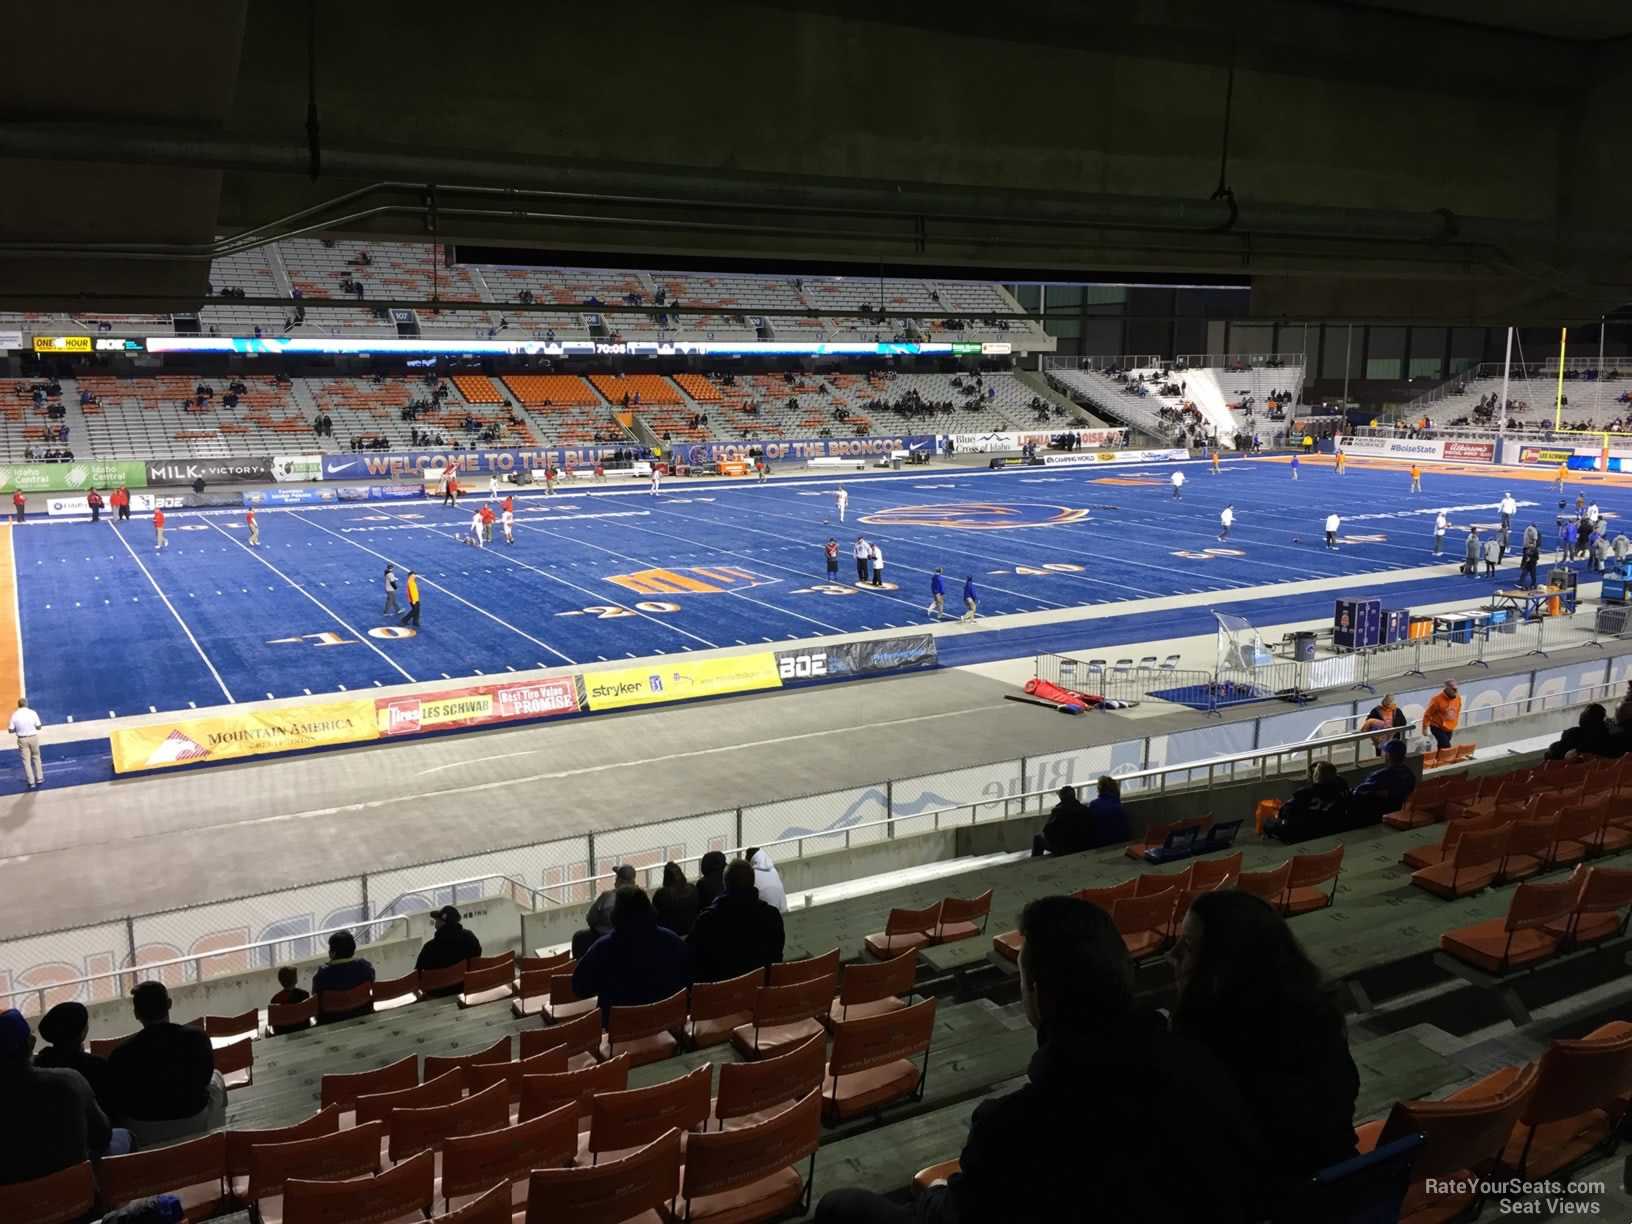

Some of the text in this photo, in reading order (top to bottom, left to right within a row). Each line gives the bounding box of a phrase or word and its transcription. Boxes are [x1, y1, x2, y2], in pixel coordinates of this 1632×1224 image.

[395, 312, 408, 320] 107
[36, 339, 88, 347] ONE HOUR
[955, 434, 975, 444] Blue
[766, 443, 792, 458] OF
[792, 441, 825, 457] THE
[829, 438, 904, 456] BRONCOS
[956, 441, 1011, 452] Cross of Idaho
[1390, 444, 1436, 454] #BoiseState
[484, 453, 514, 471] TO
[519, 451, 560, 469] THE
[1054, 456, 1077, 464] CAMPING
[14, 468, 40, 476] Idaho
[92, 465, 117, 473] Idaho
[208, 466, 259, 475] VICTORY
[14, 475, 49, 484] Central
[92, 473, 126, 481] Central
[155, 497, 184, 508] BOE
[780, 653, 827, 679] BOE
[501, 685, 563, 704] Best Tire Value
[592, 681, 642, 698] stryker
[422, 699, 490, 719] LES SCHWAB
[514, 695, 573, 715] PROMISE
[390, 706, 420, 726] Tires
[208, 718, 354, 746] MOUNTAIN AMERICA
